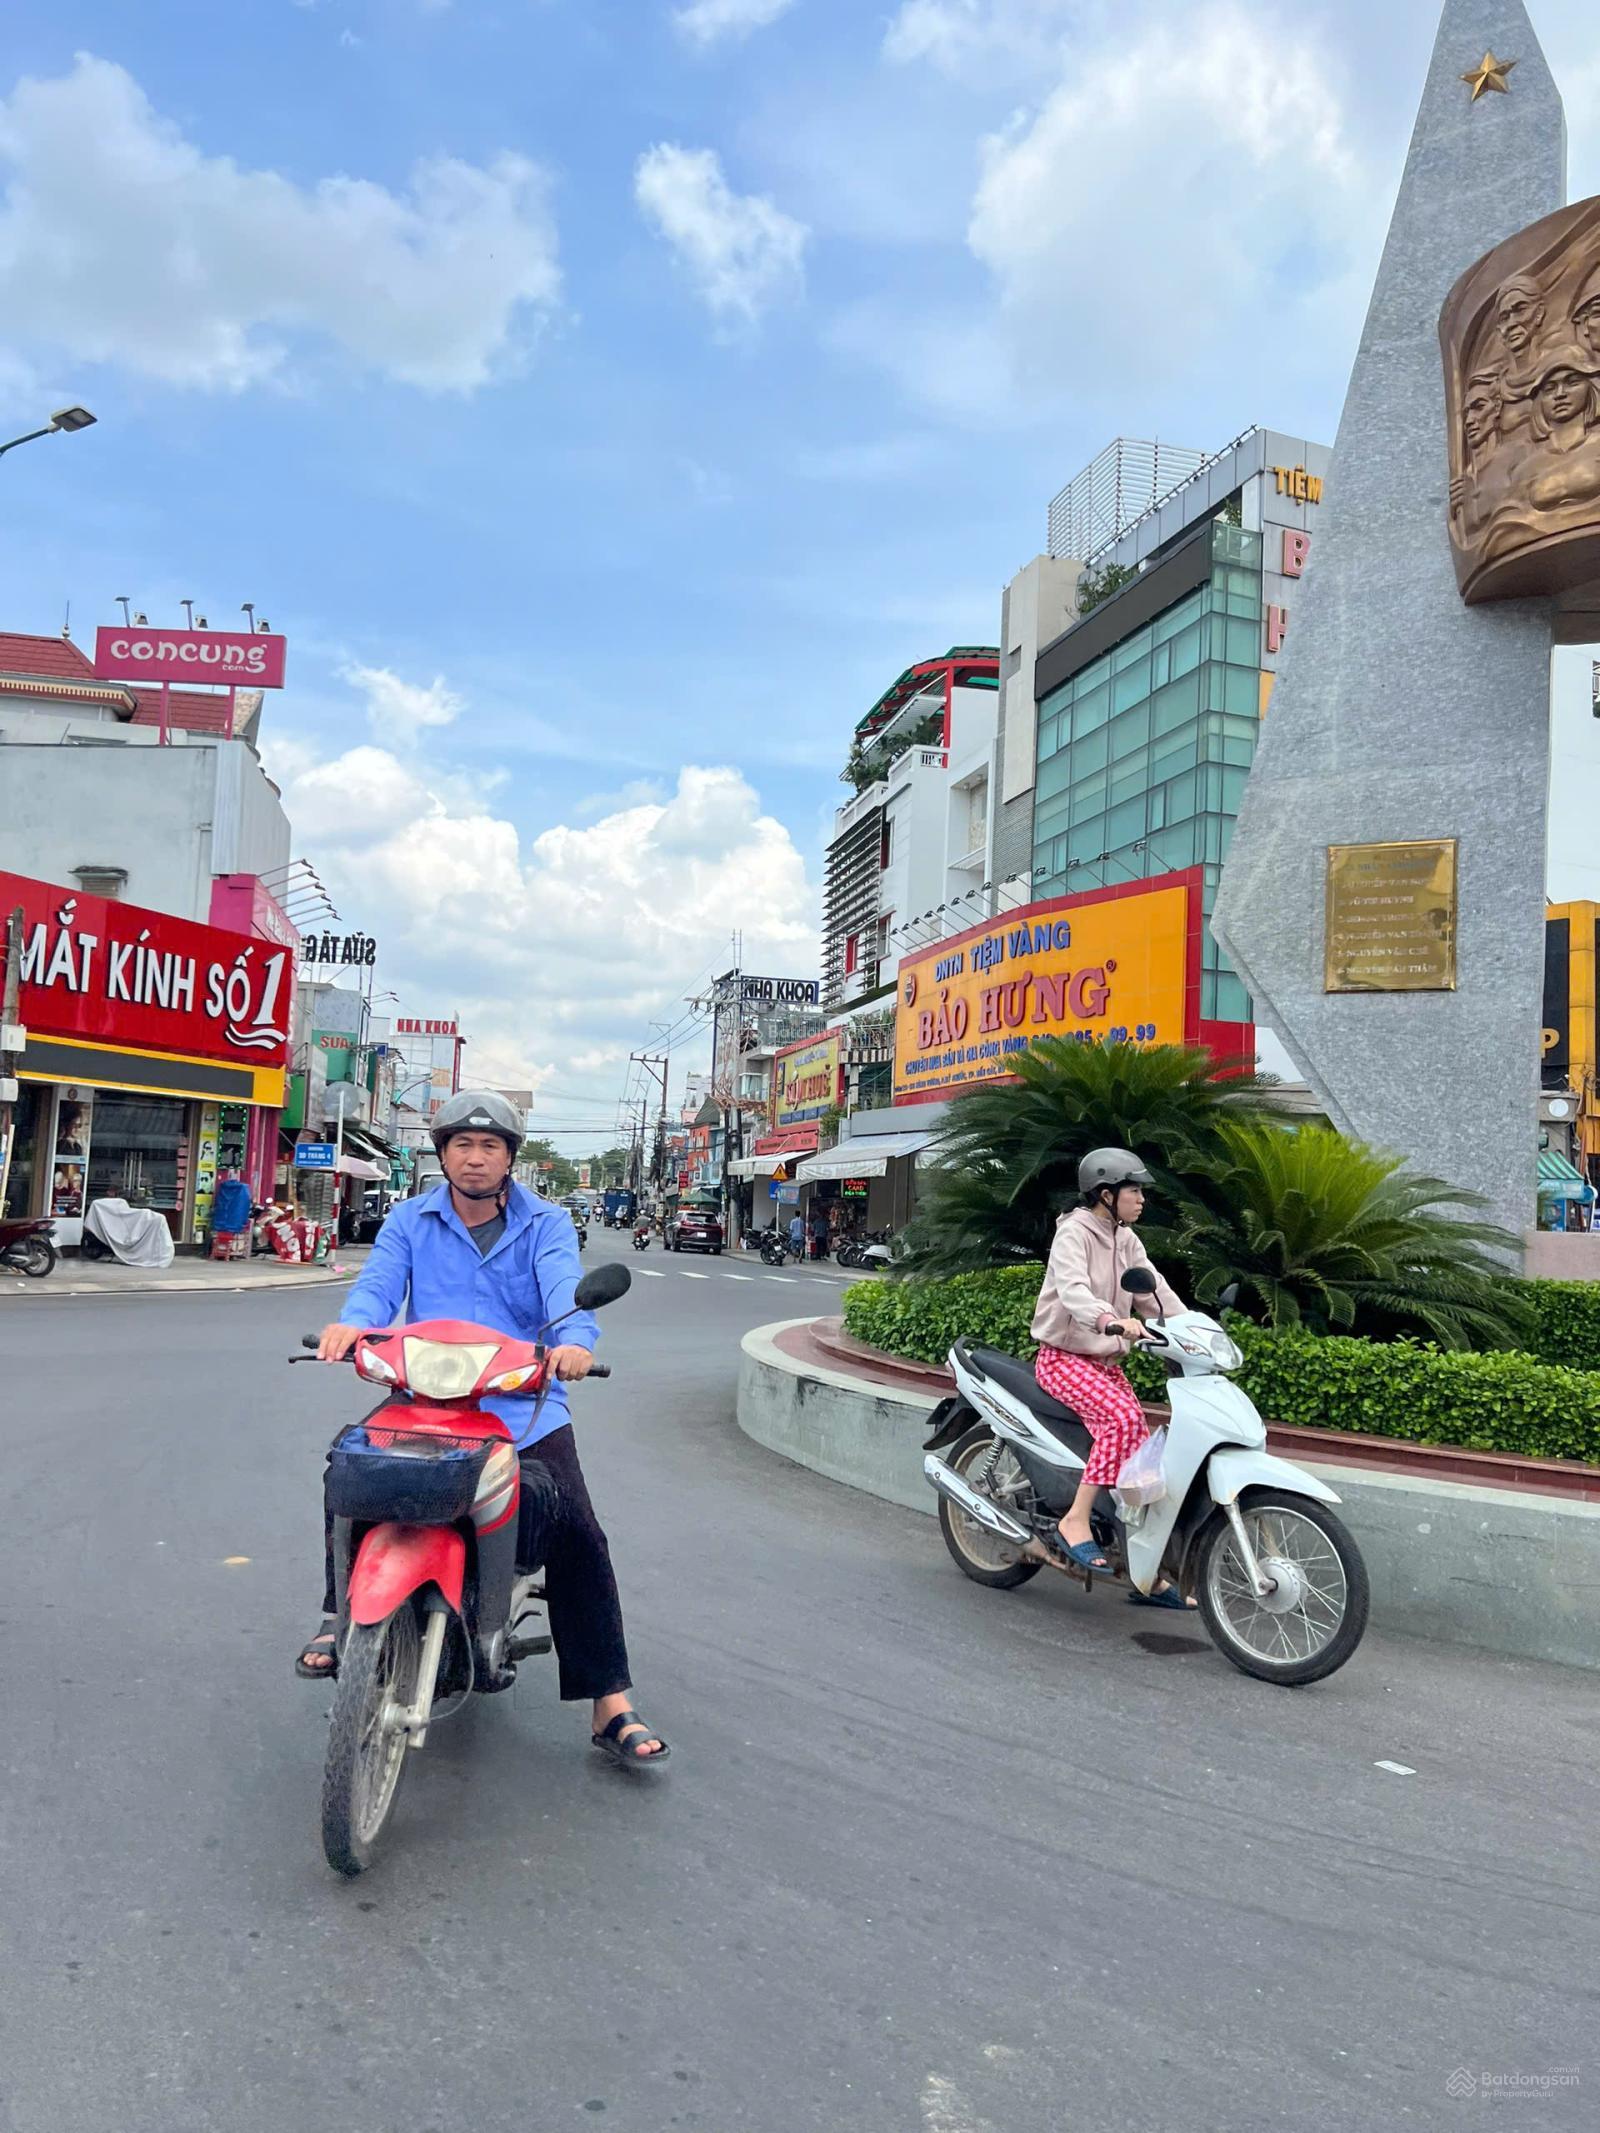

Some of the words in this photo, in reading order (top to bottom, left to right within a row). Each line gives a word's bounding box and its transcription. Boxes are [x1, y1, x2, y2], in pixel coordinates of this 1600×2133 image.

[1273, 464, 1323, 506] TIỆM
[110, 639, 268, 674] concung
[20, 898, 97, 993] MẮT
[107, 929, 196, 1013] KÍNH
[205, 946, 251, 1023] SỐ
[251, 951, 286, 1025] 1
[934, 951, 963, 983] DNTN
[970, 933, 1003, 976] TIỆM
[1006, 920, 1072, 958] VÀNG
[743, 978, 773, 999] NHA
[776, 980, 815, 1003] KHOA
[917, 990, 969, 1050] BẢO
[978, 966, 1112, 1035] HƯNG
[397, 1018, 421, 1033] NHA
[425, 1019, 457, 1035] KHOA
[978, 1039, 1000, 1058] CÔNG
